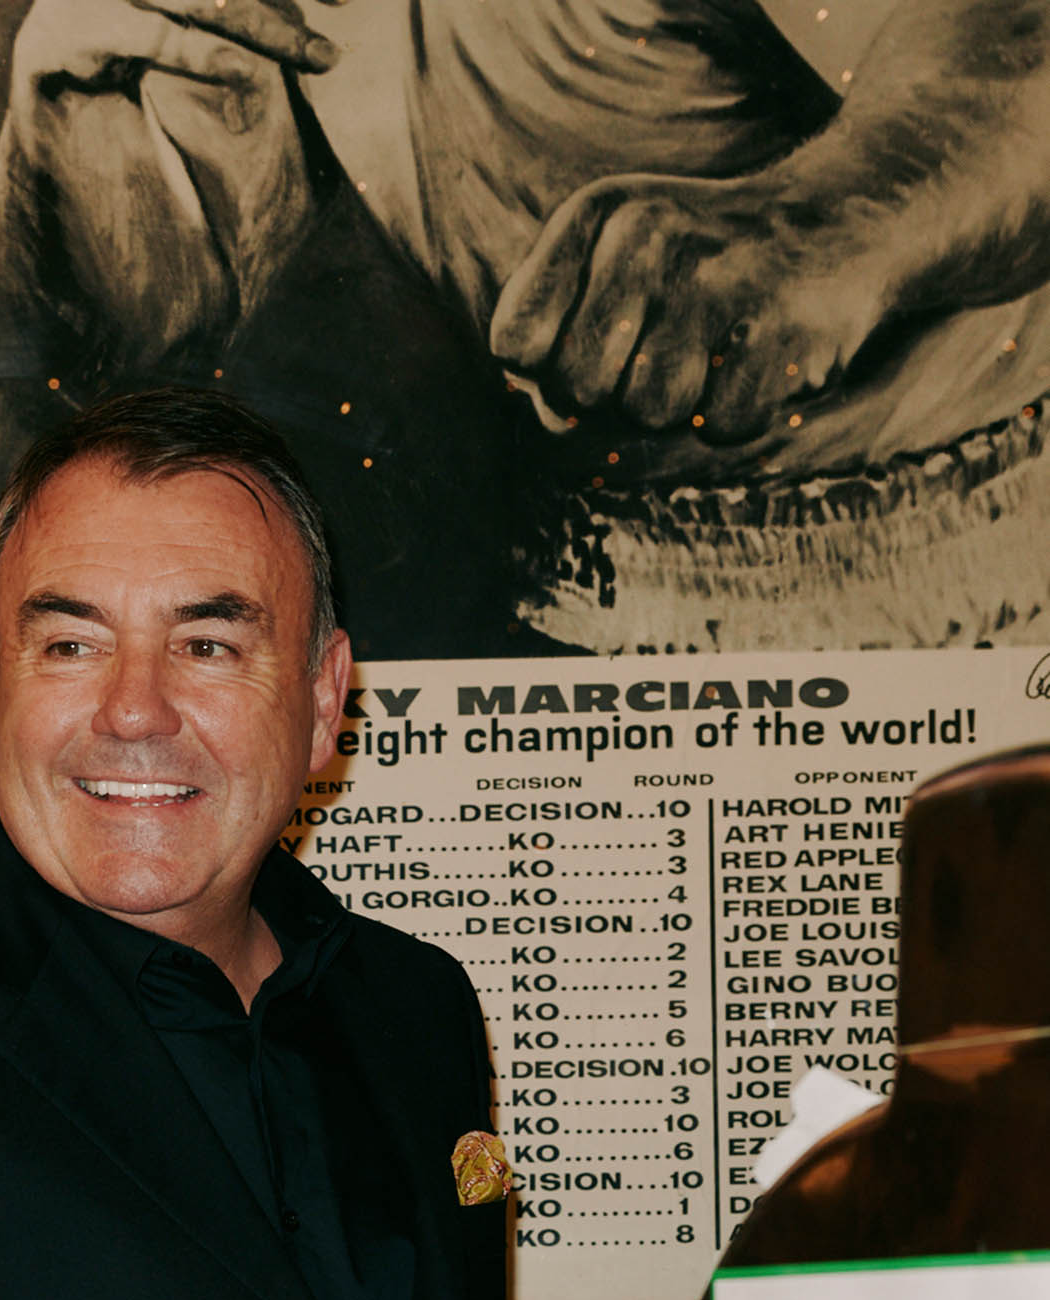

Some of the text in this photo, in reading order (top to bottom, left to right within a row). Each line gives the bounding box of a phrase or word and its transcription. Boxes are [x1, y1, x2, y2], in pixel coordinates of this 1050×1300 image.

[456, 677, 850, 716] MARCIANO
[336, 708, 977, 767] eight champion of the world!
[476, 776, 583, 792] DECISION
[634, 773, 715, 789] ROUND
[794, 770, 918, 785] OPPONENT
[458, 801, 624, 823] DECISION
[656, 799, 692, 819] 10
[722, 796, 910, 818] HAROLD MI
[316, 835, 403, 854] HAFT
[508, 832, 556, 851] KO
[666, 829, 687, 848] 3
[724, 824, 789, 844] ART
[508, 858, 555, 879] KO
[667, 856, 688, 875] 3
[721, 847, 902, 870] RED APPLE
[722, 872, 884, 894] REX LANE
[362, 888, 491, 910] GORGIO
[510, 888, 557, 908] KO
[667, 885, 688, 905] 4
[722, 897, 861, 918] FREDDIE
[464, 913, 693, 936] DECISION 10
[723, 920, 901, 943] JOE LOUIS
[511, 942, 687, 965] KO 2
[723, 949, 782, 969] LEE
[511, 971, 688, 993] KO 2
[726, 975, 812, 995] GINO
[512, 1000, 688, 1022] KO 5
[725, 998, 898, 1021] BERNY RE
[513, 1028, 686, 1050] KO 6
[725, 1026, 898, 1048] HARRY MA
[511, 1057, 712, 1080] DECISION 10
[726, 1054, 793, 1075] JOE
[512, 1085, 691, 1108] KO 3
[726, 1080, 791, 1100] JOE
[513, 1113, 700, 1136] KO 10
[514, 1141, 694, 1164] KO 6
[669, 1170, 704, 1190] 10
[516, 1197, 689, 1219] KO 1
[516, 1224, 695, 1248] KO 8
